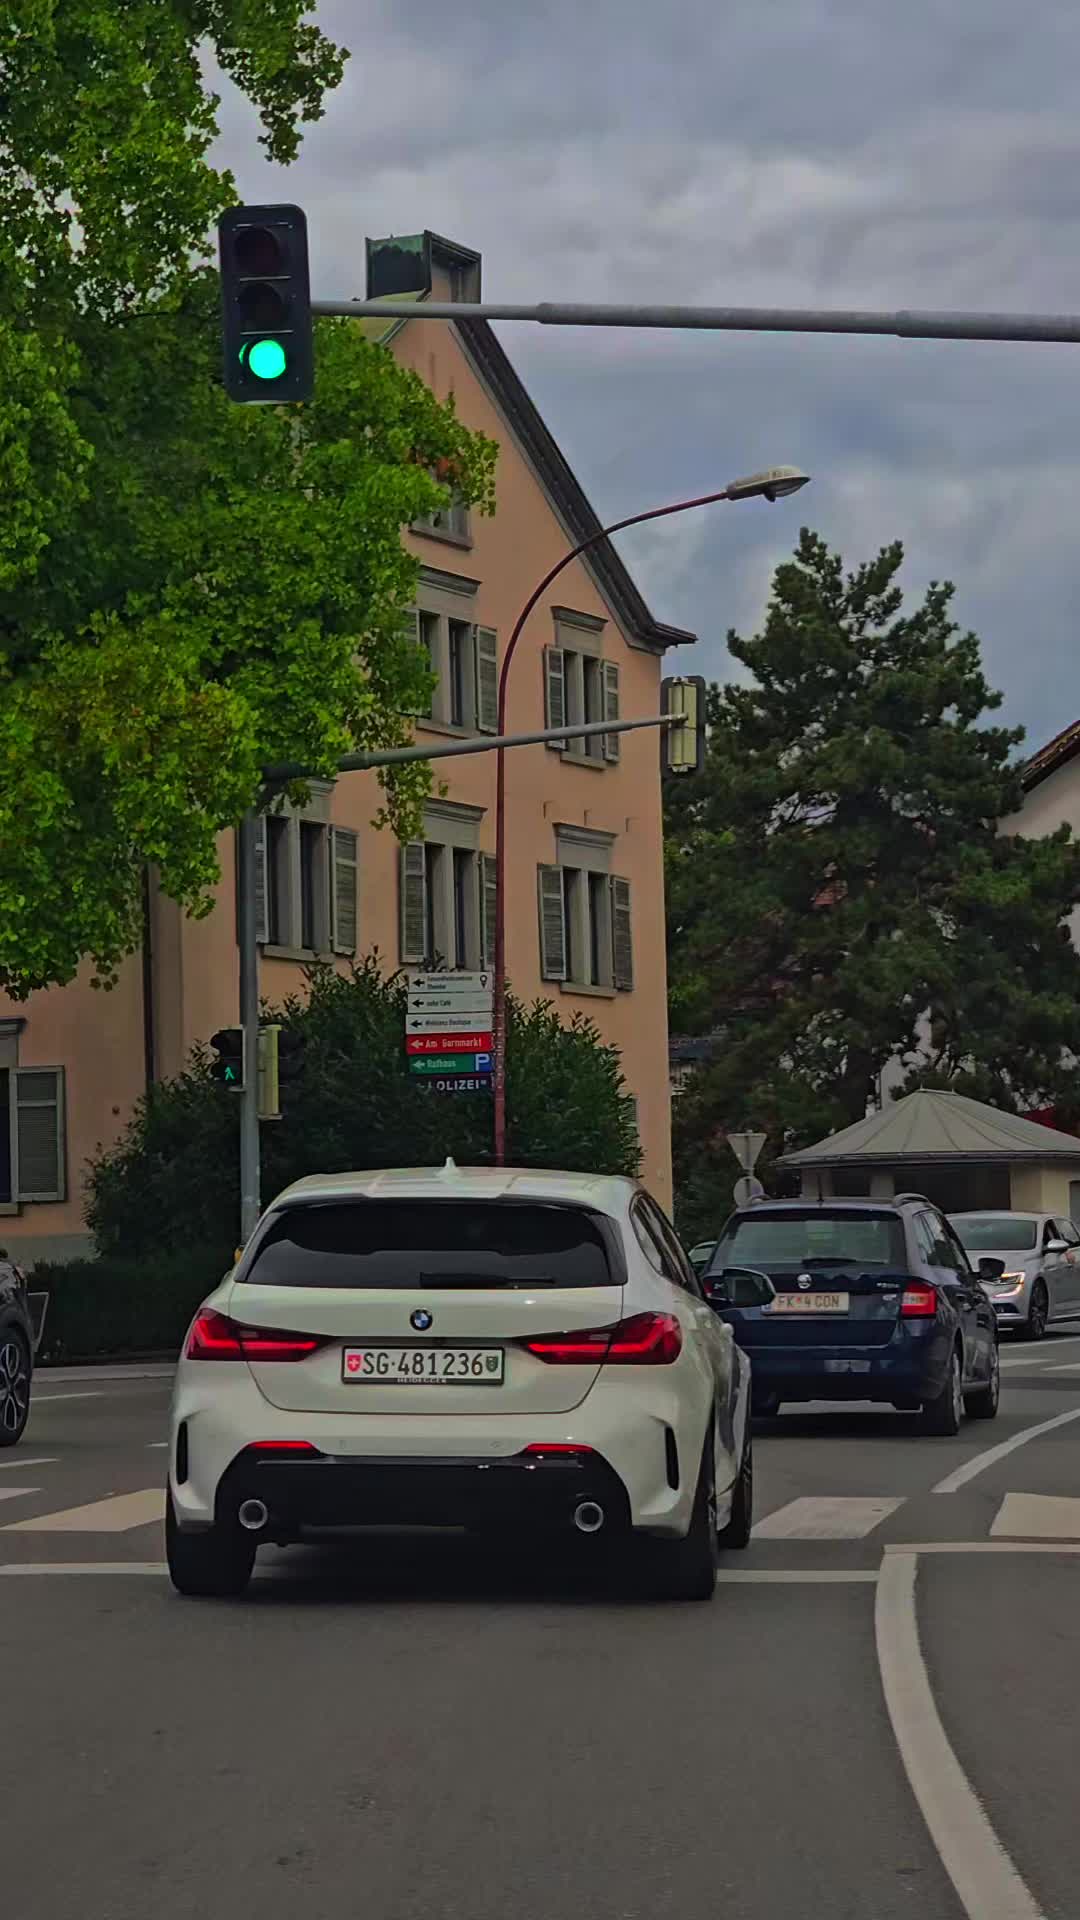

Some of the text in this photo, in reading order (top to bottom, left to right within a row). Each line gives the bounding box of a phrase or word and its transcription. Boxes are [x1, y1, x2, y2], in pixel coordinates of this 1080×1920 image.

[425, 1037, 482, 1049] Am Garnmarkt
[427, 1059, 457, 1069] Rathaus
[475, 1053, 490, 1071] P
[433, 1079, 479, 1091] OLIZEI
